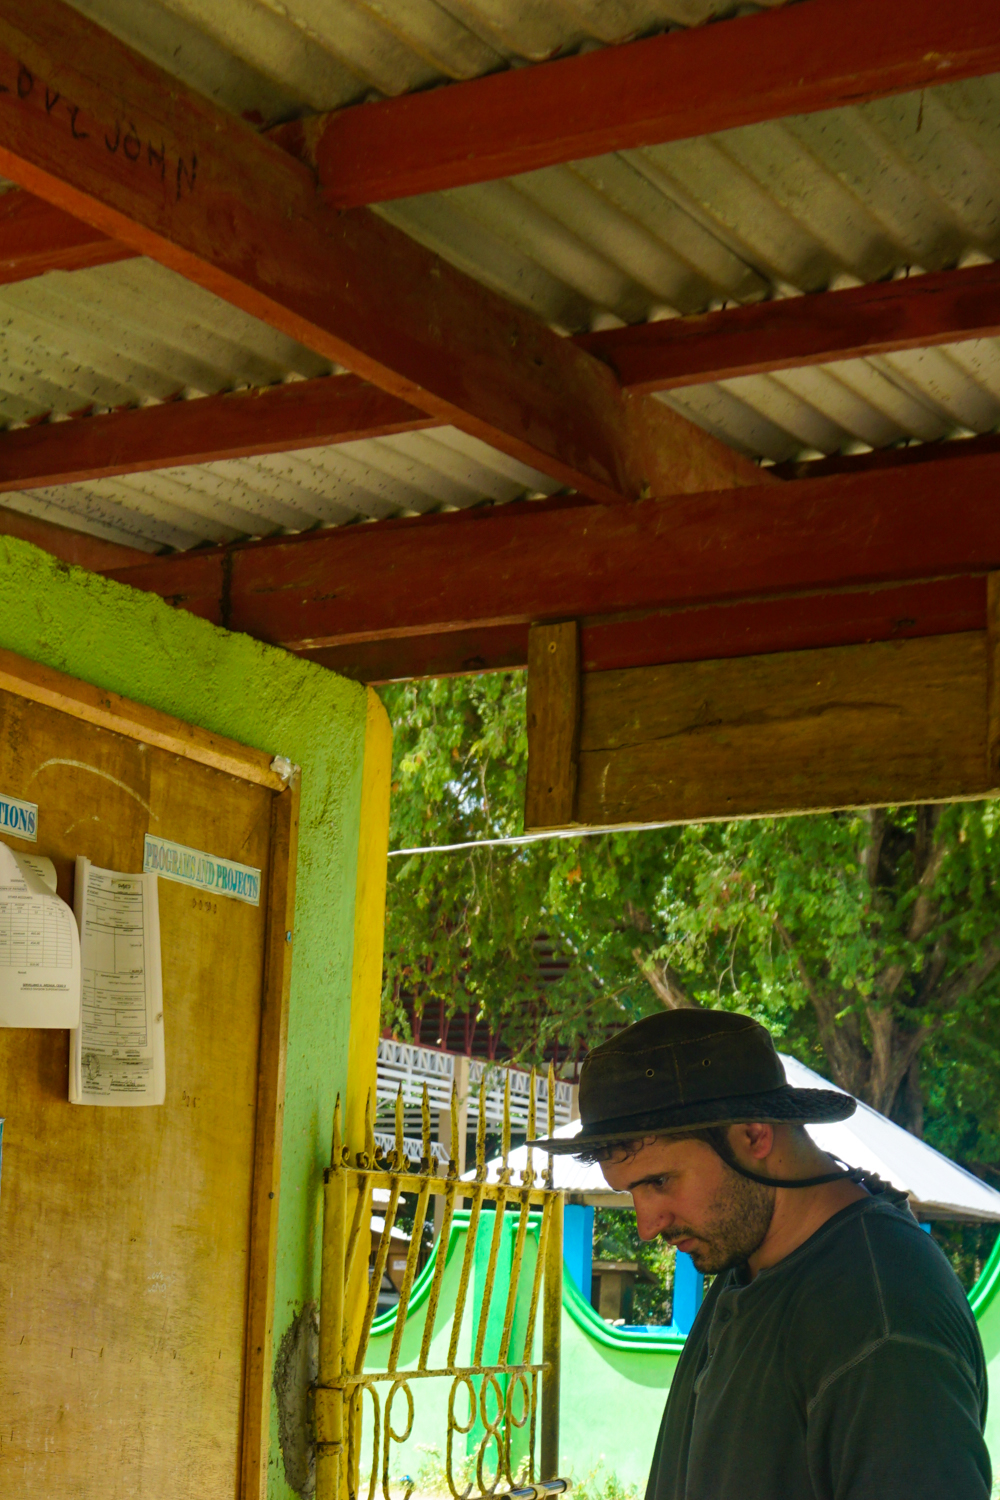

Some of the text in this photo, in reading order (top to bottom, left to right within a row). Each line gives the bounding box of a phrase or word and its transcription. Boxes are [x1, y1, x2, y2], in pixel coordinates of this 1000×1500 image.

[145, 842, 259, 899] PROGRAMS AND PROJECTS
